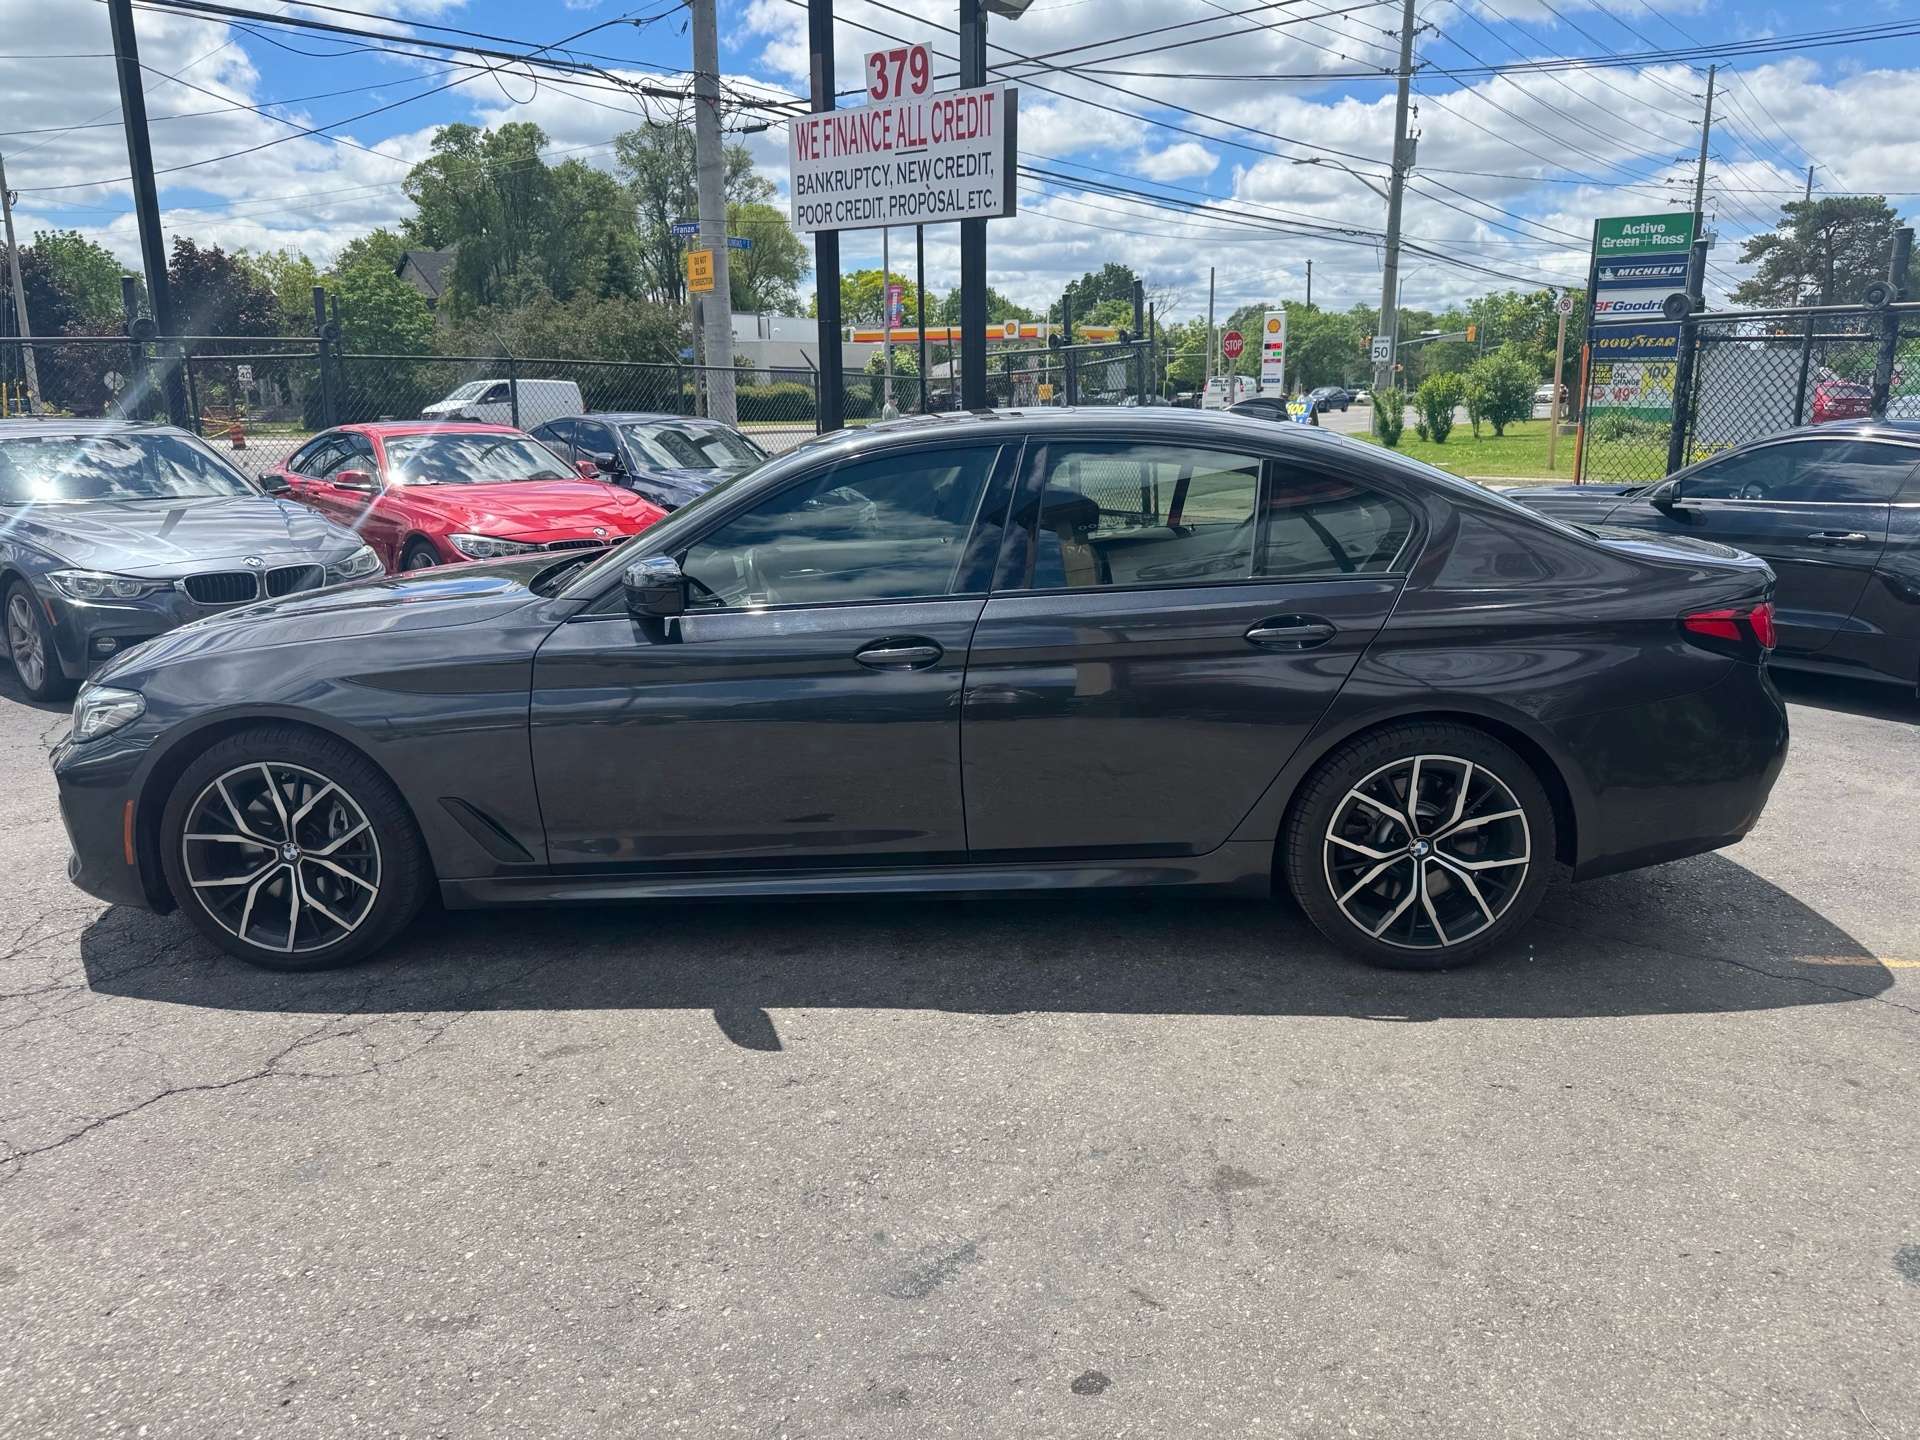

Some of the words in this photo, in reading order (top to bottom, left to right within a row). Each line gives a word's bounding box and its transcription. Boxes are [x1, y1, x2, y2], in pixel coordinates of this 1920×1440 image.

[869, 46, 929, 100] 379
[795, 120, 819, 161] WE
[823, 110, 892, 158] FINANCE
[895, 104, 927, 149] ALL
[931, 93, 994, 144] CREDIT
[797, 164, 893, 195] BANKRUPTCY,
[933, 152, 994, 178] CREDIT,
[798, 203, 832, 226] POOR
[835, 197, 886, 221] CREDIT,
[968, 189, 997, 210] ETC.
[1622, 222, 1666, 236] Active
[1617, 265, 1684, 277] MICHELIN
[1225, 340, 1242, 352] STOP
[1374, 347, 1388, 359] 50
